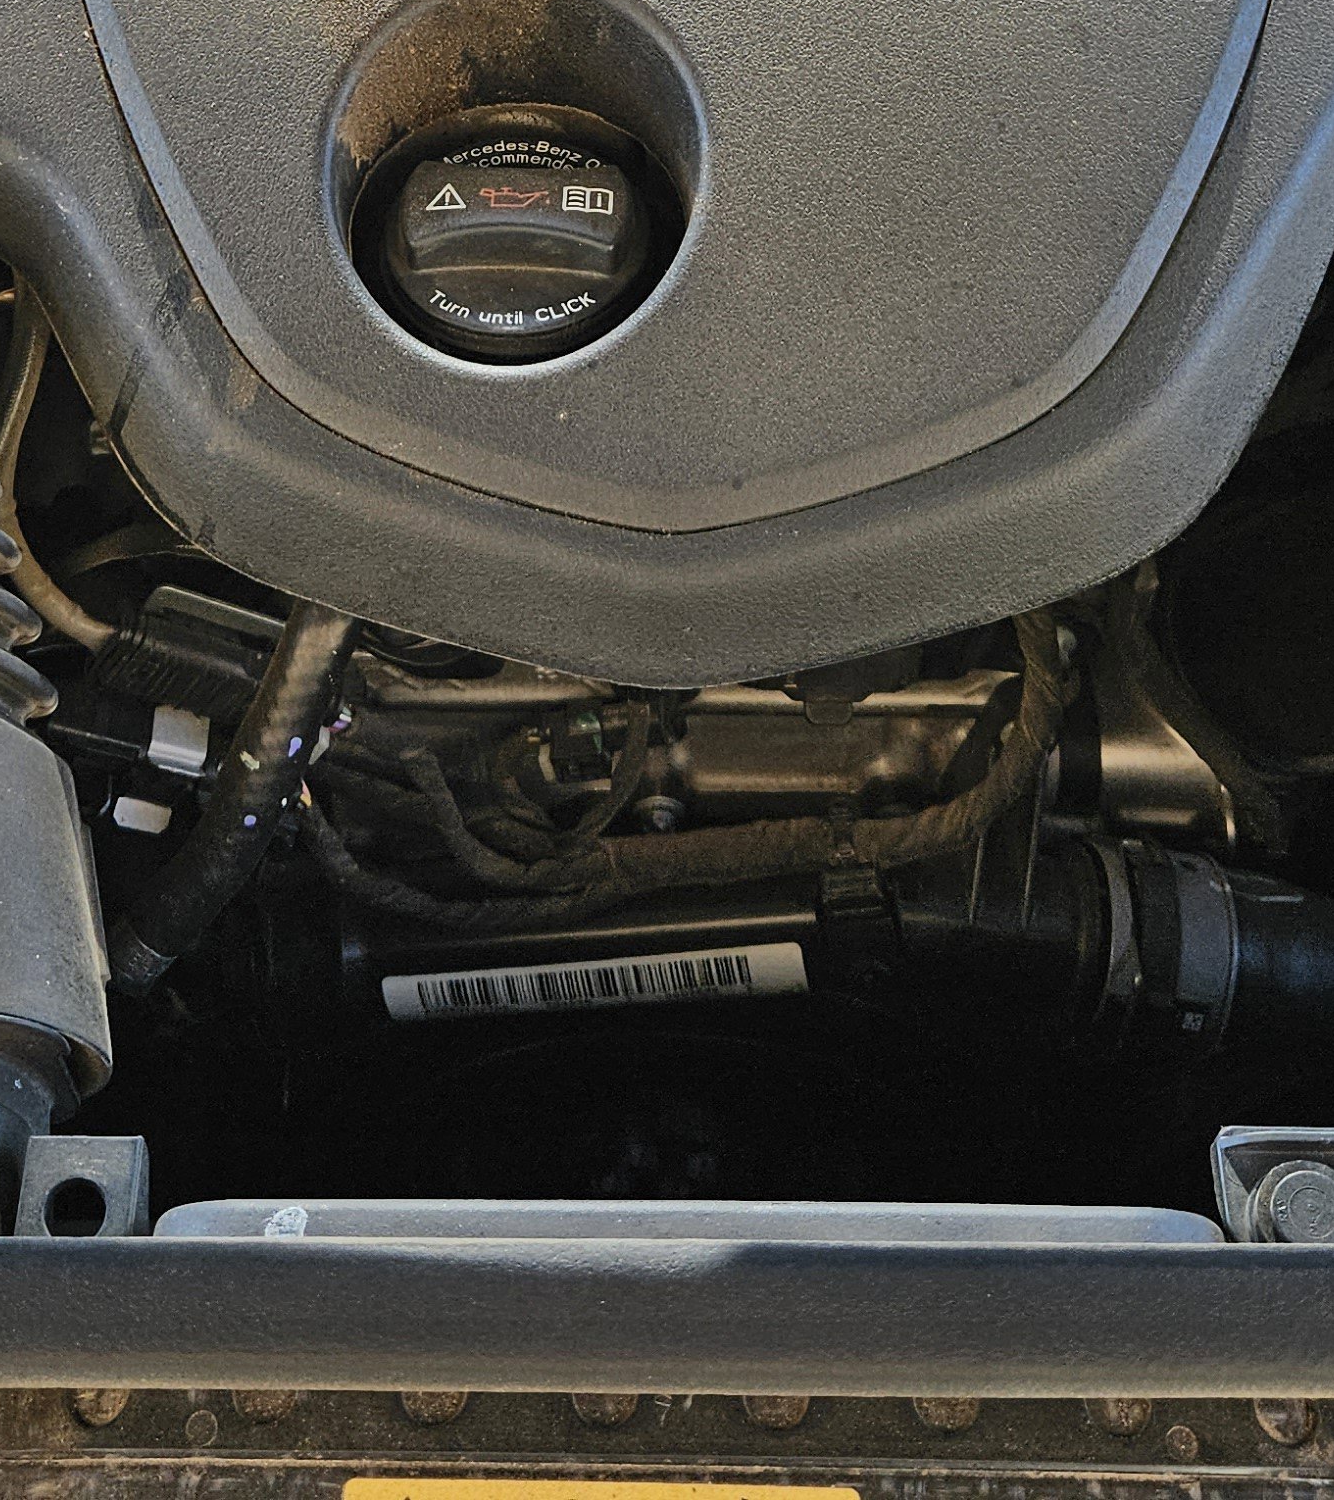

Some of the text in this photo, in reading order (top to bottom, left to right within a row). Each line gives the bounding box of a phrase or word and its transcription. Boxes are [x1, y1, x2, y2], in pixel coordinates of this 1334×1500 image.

[428, 289, 597, 326] Turn until CLICK
